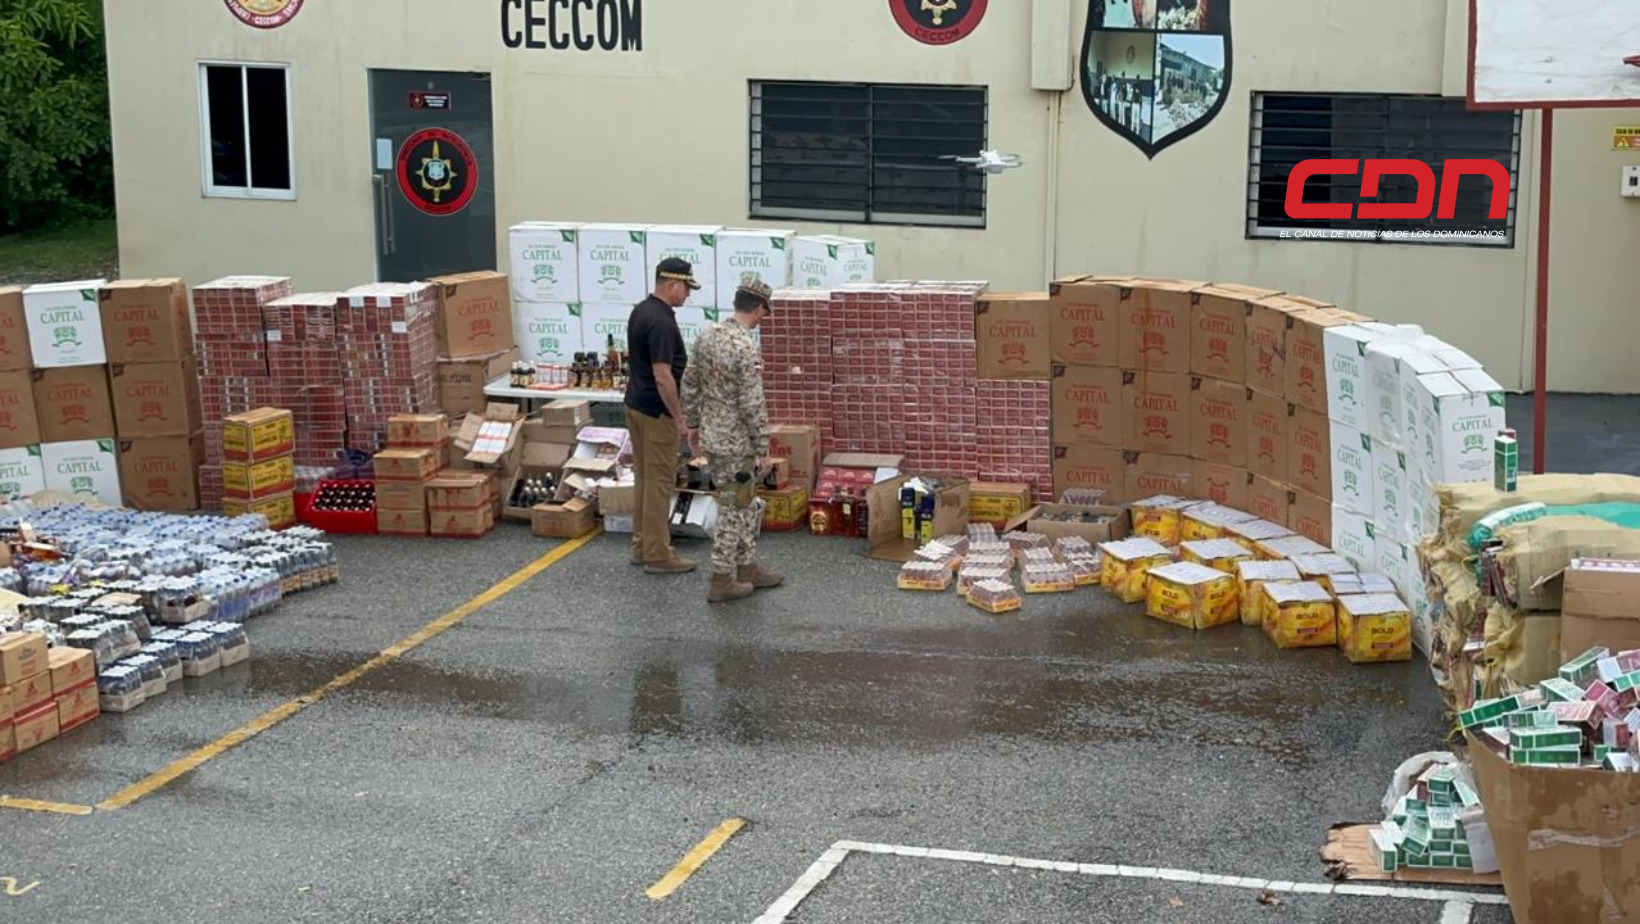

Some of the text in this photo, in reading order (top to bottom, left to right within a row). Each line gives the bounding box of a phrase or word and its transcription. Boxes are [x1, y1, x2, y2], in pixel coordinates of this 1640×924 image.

[501, 0, 642, 51] CECCOM
[915, 27, 960, 41] CECCOM
[522, 249, 563, 260] CAPITAL
[590, 250, 632, 261] CAPITAL
[729, 256, 771, 267] CAPITAL
[801, 261, 828, 276] CAPITAL
[114, 309, 160, 322] CAPITAL
[458, 302, 501, 317] CAPITAL
[1060, 307, 1106, 321] CAPITAL
[40, 310, 86, 324] CAPITAL
[1130, 313, 1177, 329] CAPITAL
[528, 322, 568, 334] CAPITAL
[594, 323, 628, 334] CAPITA
[989, 325, 1037, 338] CAPITAL
[1200, 316, 1237, 337] CAPITAL
[1332, 358, 1360, 378] CAPITAL
[48, 386, 94, 400] CAPITAL
[125, 383, 171, 397] CAPITAL
[1065, 388, 1109, 404] CAPITAL
[1134, 397, 1180, 412] CAPITAL
[1200, 402, 1238, 421] CAPITAL
[1452, 418, 1492, 431] CAPITAL
[57, 460, 103, 474] CAPITAL
[134, 460, 180, 473] CAPITAL
[1066, 470, 1112, 485] CAPITAL
[1137, 476, 1183, 493] CAPITAL
[1296, 612, 1319, 620] BOLD
[1371, 627, 1395, 635] BOLD
